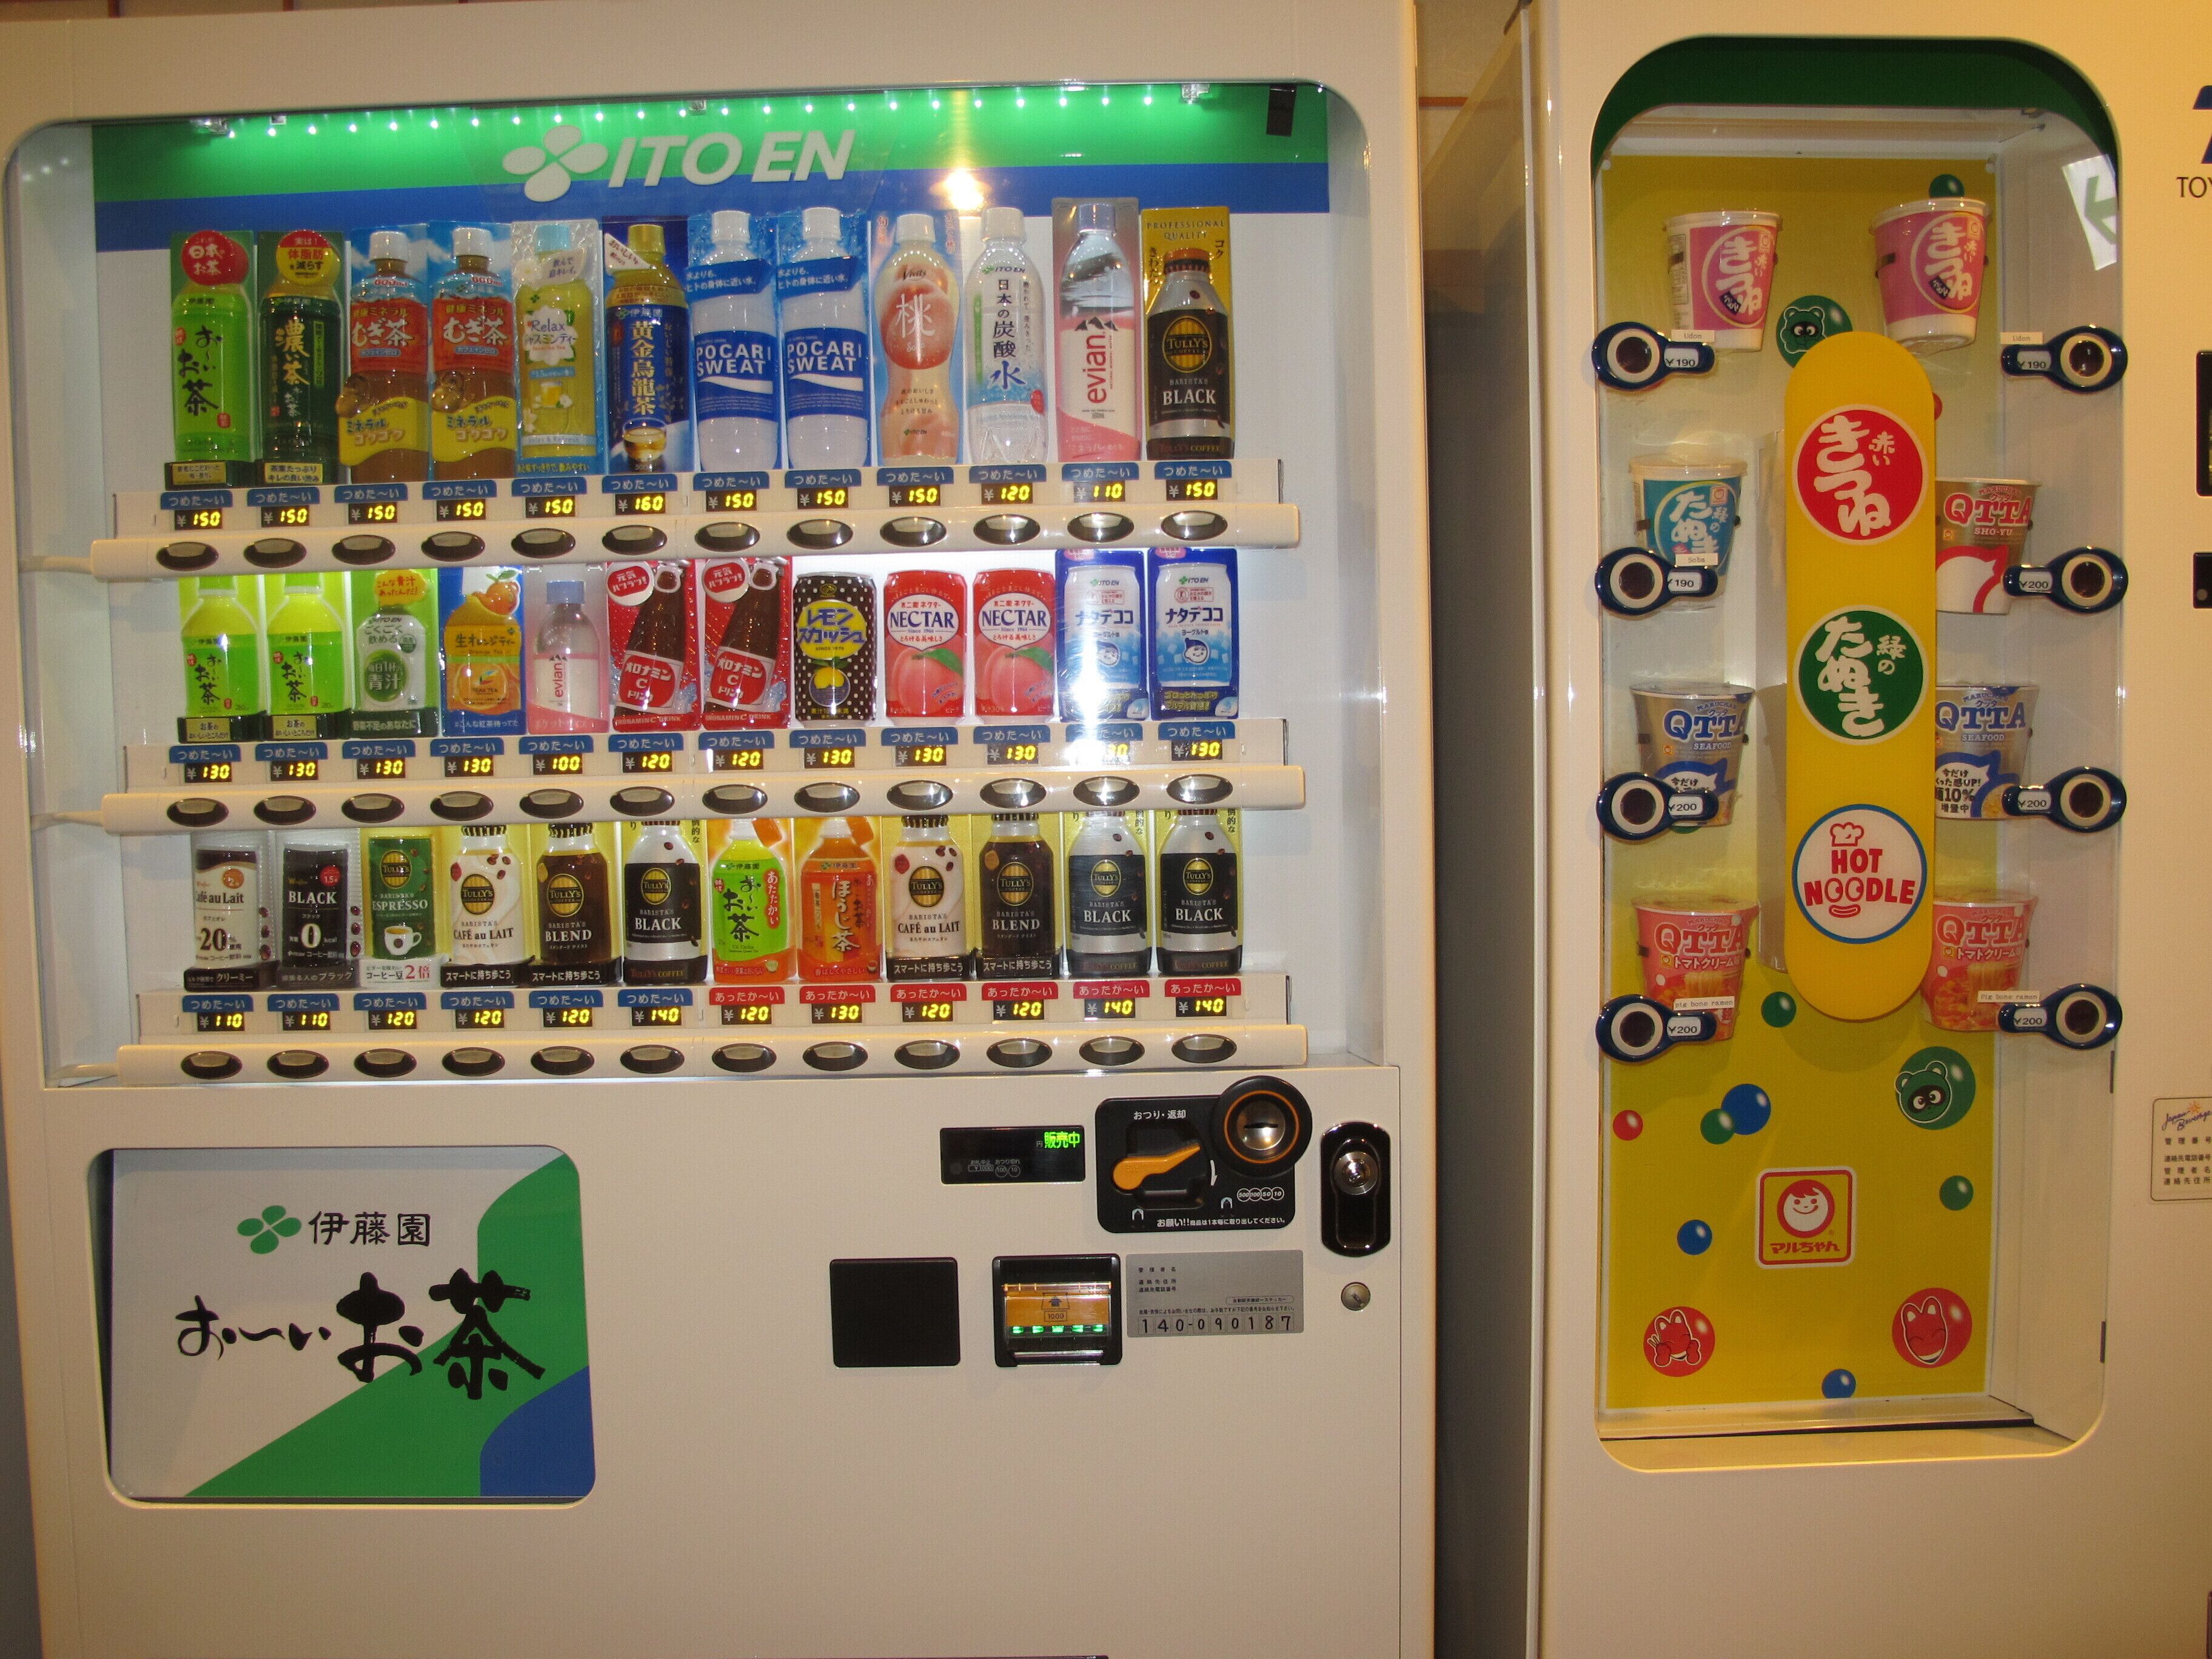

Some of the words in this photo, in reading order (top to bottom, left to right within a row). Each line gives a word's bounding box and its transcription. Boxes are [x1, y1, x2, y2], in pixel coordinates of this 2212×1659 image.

[608, 132, 743, 189] ITO
[752, 130, 857, 183] EN
[1147, 220, 1225, 229] PROFESSIONAL
[1164, 232, 1208, 241] QUALITY
[896, 293, 936, 338] 桃
[352, 317, 414, 347] むぎ茶
[443, 315, 508, 346] むぎ茶
[532, 318, 565, 332] Relax
[988, 280, 1026, 390] 日本の炭酸水
[788, 341, 862, 358] POCARI
[1167, 338, 1208, 349] TULLY'S
[697, 343, 771, 362] POCARI
[697, 360, 766, 377] SWEAT
[788, 356, 856, 374] SWEAT
[1163, 389, 1216, 406] BLACK
[1868, 431, 1895, 466] 赤い
[1813, 415, 1892, 537] きつね
[1944, 492, 2031, 526] QTTA
[1974, 527, 2013, 536] SHO-YU
[808, 608, 854, 627] レモン
[890, 611, 955, 629] NECTAR
[982, 609, 1048, 628] NECTAR
[1165, 607, 1224, 624] ナタデココ
[455, 634, 515, 648] 生オレンジティー
[798, 626, 865, 644] スカッシュ
[1875, 634, 1908, 675] 緑の
[368, 673, 401, 691] 青汁
[636, 678, 648, 689] C
[727, 674, 739, 685] C
[1814, 615, 1885, 737] たぬき
[1935, 701, 2026, 732] QTTA
[1961, 733, 2005, 742] SEAFOOD
[1693, 742, 1732, 751] SEAFOOD
[1942, 768, 1969, 778] 今だけ
[1671, 777, 1698, 786] 今だけ
[1941, 803, 1969, 814] 増量中
[1831, 848, 1883, 874] HOT
[1000, 879, 1031, 888] TULLY'S
[1185, 871, 1212, 880] TULLY'S
[462, 888, 494, 899] TULLY'S
[911, 881, 943, 890] TULLY'S
[1803, 877, 1916, 907] NOODLE
[288, 890, 338, 905] BLACK
[549, 889, 582, 899] TULLY'S
[766, 870, 779, 925] あたたかい
[723, 888, 759, 943] お茶
[831, 880, 860, 953] ほうじ茶
[1083, 909, 1132, 923] BLACK
[1175, 907, 1224, 922] BLACK
[635, 917, 682, 931] BLACK
[898, 922, 921, 934] CAFÉ
[939, 920, 960, 933] LAIT
[992, 918, 1041, 931] BLEND
[200, 927, 228, 951] 20
[300, 923, 323, 949] 0
[454, 928, 472, 940] CAFÉ
[474, 931, 486, 940] au
[489, 927, 514, 939] LAIT
[545, 929, 593, 943] BLEND
[1654, 922, 1746, 957] QTTA
[404, 964, 431, 980] 2倍
[894, 962, 964, 975] スマートに持ち歩こう
[982, 959, 1053, 972] スマートに持ち歩こう
[366, 971, 403, 980] コーヒー豆
[446, 970, 511, 981] スマートに持ち歩こう
[532, 970, 602, 982] スマートに持ち歩こう
[1133, 1109, 1187, 1121] おつり・返却
[1044, 1131, 1081, 1149] 販売中
[308, 1210, 432, 1249] 伊藤園
[1770, 1241, 1841, 1255] マルちゃん
[1142, 1315, 1291, 1333] 140-090187
